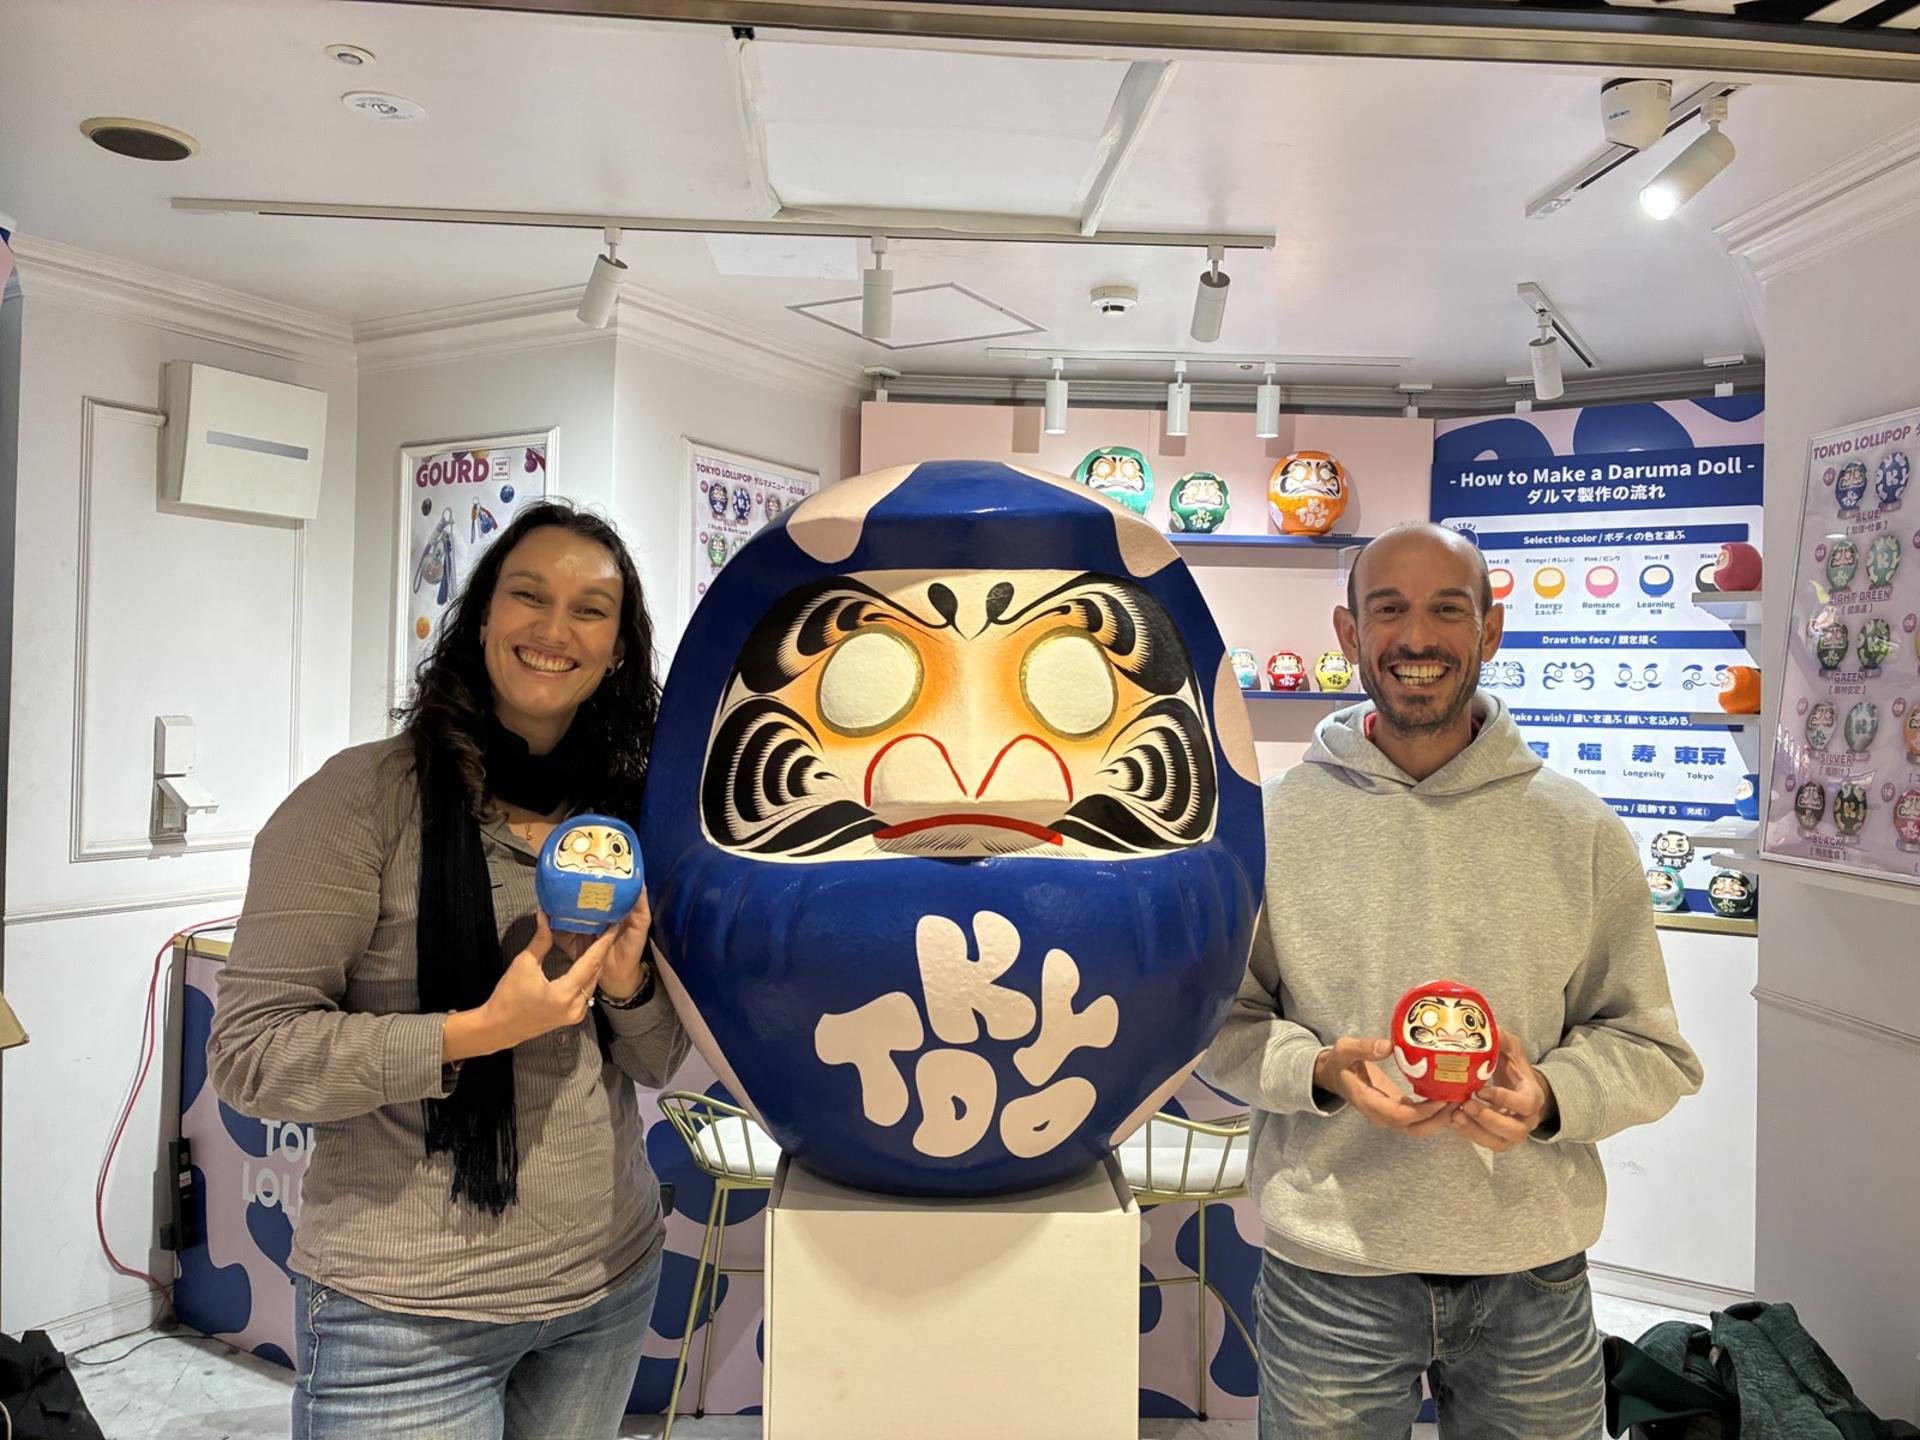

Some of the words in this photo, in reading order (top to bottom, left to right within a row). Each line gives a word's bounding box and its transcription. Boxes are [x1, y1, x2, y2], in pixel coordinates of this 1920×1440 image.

[1814, 440, 1852, 460] TOKYO
[1855, 426, 1911, 451] LOLLIPOP
[416, 457, 489, 488] GOURD
[696, 463, 721, 476] TOKYO
[722, 469, 752, 482] LOLLIPOP
[1461, 472, 1503, 487] How
[1507, 471, 1528, 485] to
[1533, 466, 1585, 484] Make
[1591, 469, 1602, 481] a
[1608, 463, 1691, 481] Daruma
[1698, 457, 1741, 475] Doll
[1527, 484, 1666, 505] ダルマ製作の流れ
[1856, 510, 1880, 521] BLUE
[1524, 535, 1553, 545] Select
[1555, 535, 1570, 544] the
[1572, 534, 1597, 544] color
[1604, 530, 1686, 543] ボディの色を選ぶ
[1860, 590, 1890, 600] GREEN
[1534, 603, 1563, 611] Energy
[1637, 601, 1675, 609] Learning
[1542, 636, 1569, 644] Draw
[1570, 635, 1588, 644] the
[1589, 635, 1610, 644] face
[1835, 673, 1863, 681] GREEN
[1542, 713, 1565, 722] wish
[1578, 743, 1602, 761] 福
[1632, 744, 1656, 763] 寿
[1674, 746, 1726, 766] 東京
[1820, 753, 1852, 764] SILVER
[1574, 768, 1606, 776] Fortune
[1623, 770, 1665, 779] Longevity
[1687, 772, 1714, 781] Tokyo
[1813, 835, 1842, 846] BLACK
[814, 910, 1119, 1159] TOKYO
